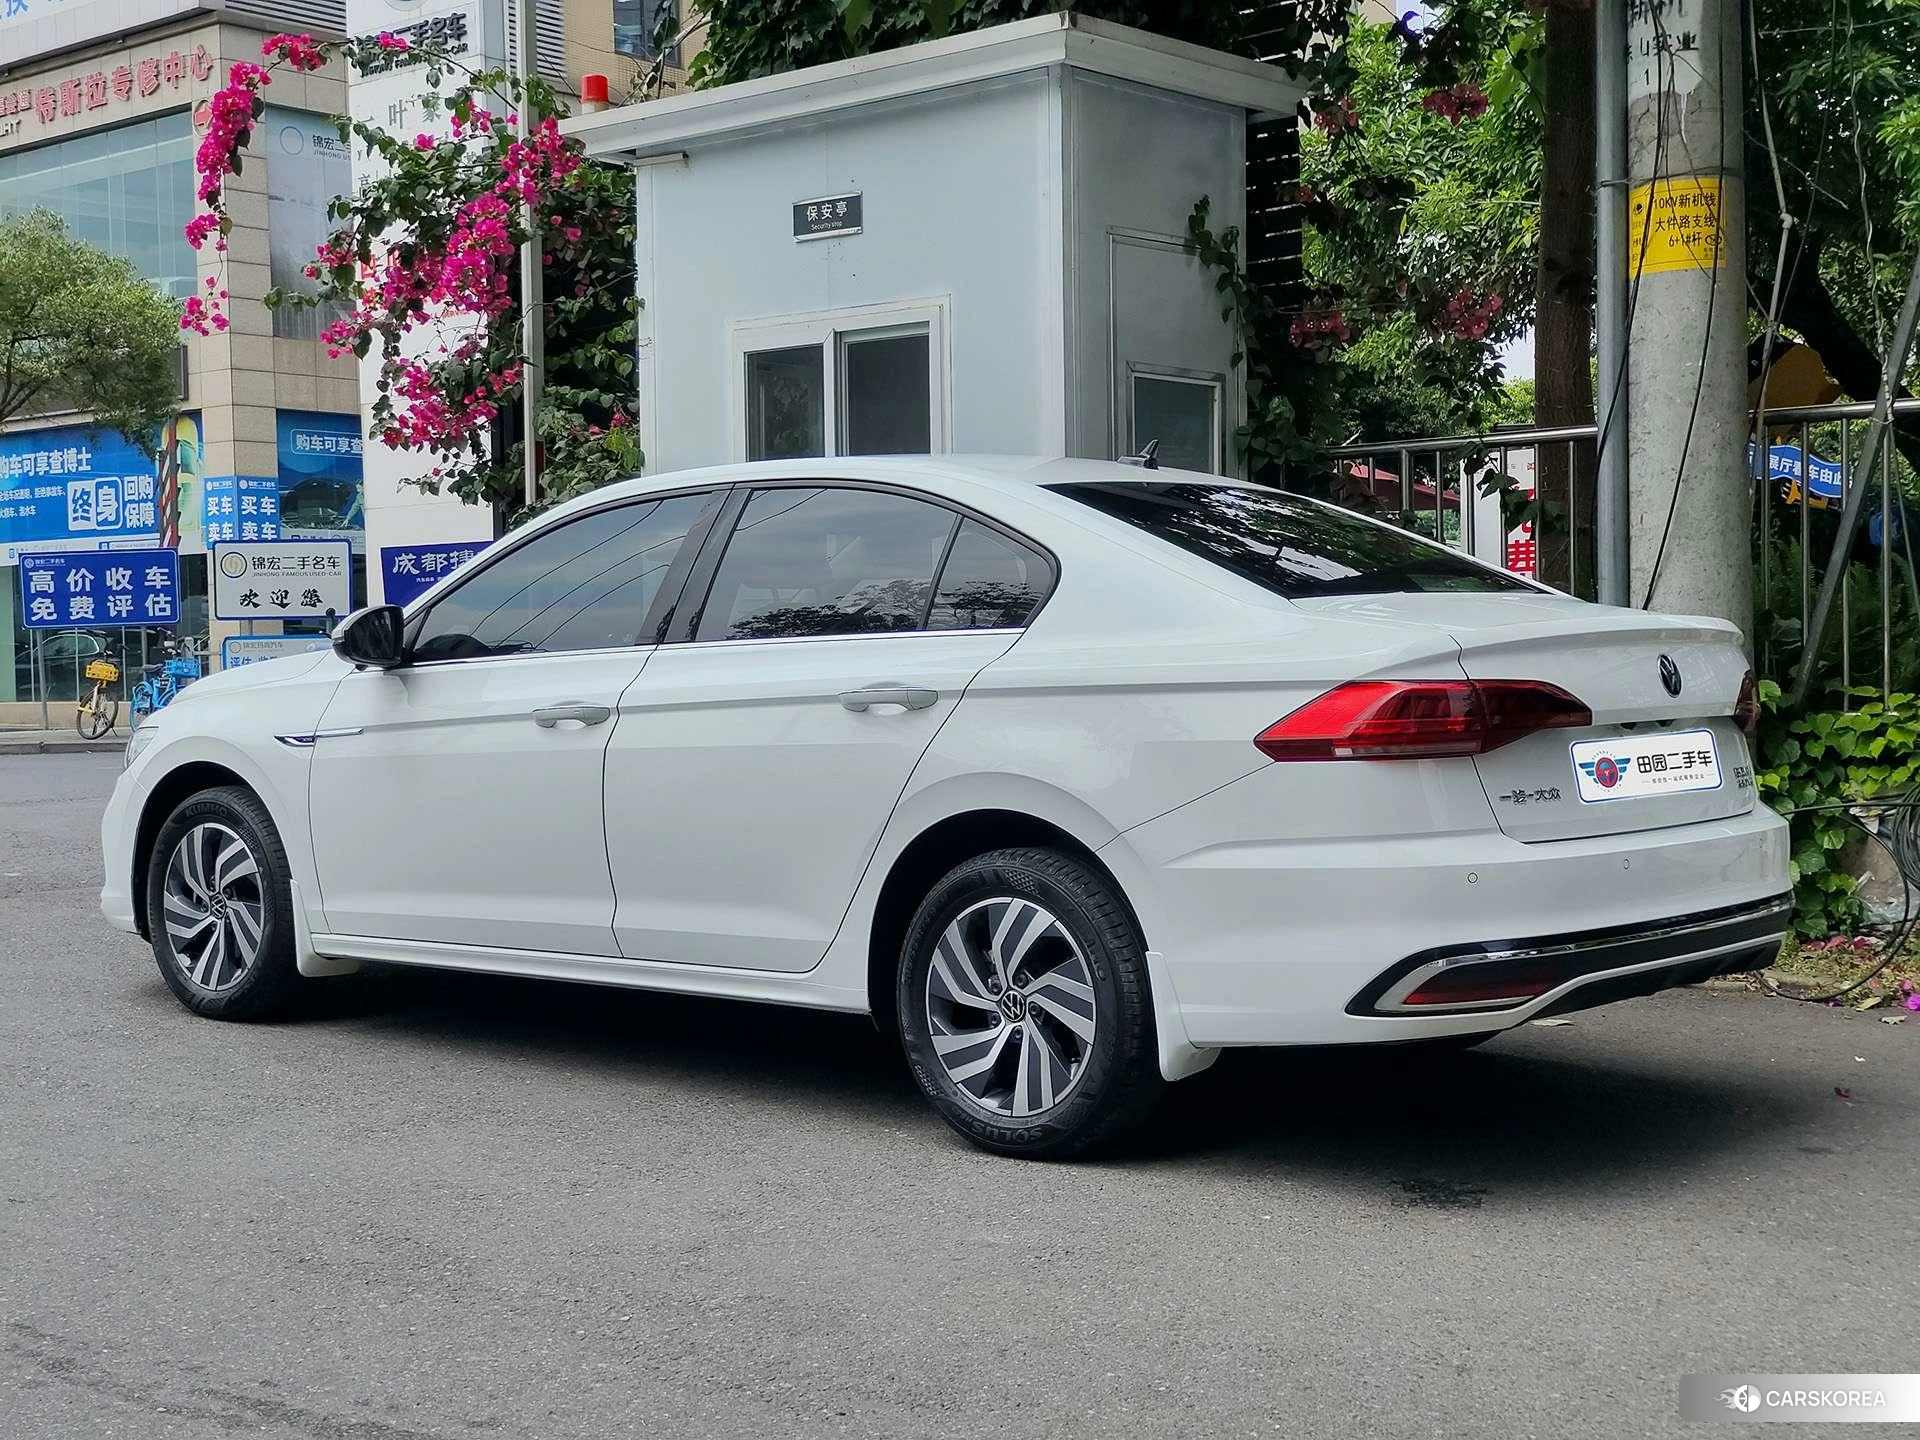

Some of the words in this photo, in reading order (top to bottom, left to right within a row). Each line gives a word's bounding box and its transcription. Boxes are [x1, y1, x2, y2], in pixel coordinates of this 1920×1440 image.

[35, 43, 212, 124] 特斯拉专修中心
[806, 200, 848, 222] 保安亭
[1655, 212, 1716, 233] 大件路支线
[295, 433, 364, 454] 购车可享查
[0, 446, 93, 479] 购车可享查博士
[123, 474, 154, 501] 回购
[71, 485, 119, 524] 终身
[124, 502, 156, 529] 保障
[207, 495, 233, 517] 买车
[240, 495, 277, 516] 买车
[208, 521, 234, 543] 卖车
[242, 521, 278, 541] 卖车
[251, 555, 341, 571] 锦宏二手名车
[28, 566, 171, 594] 高价收车
[29, 593, 172, 622] 免费评估
[239, 588, 324, 609] 欢迎您
[1636, 750, 1714, 774] 田园二手车
[971, 1121, 1042, 1146] SOLUS
